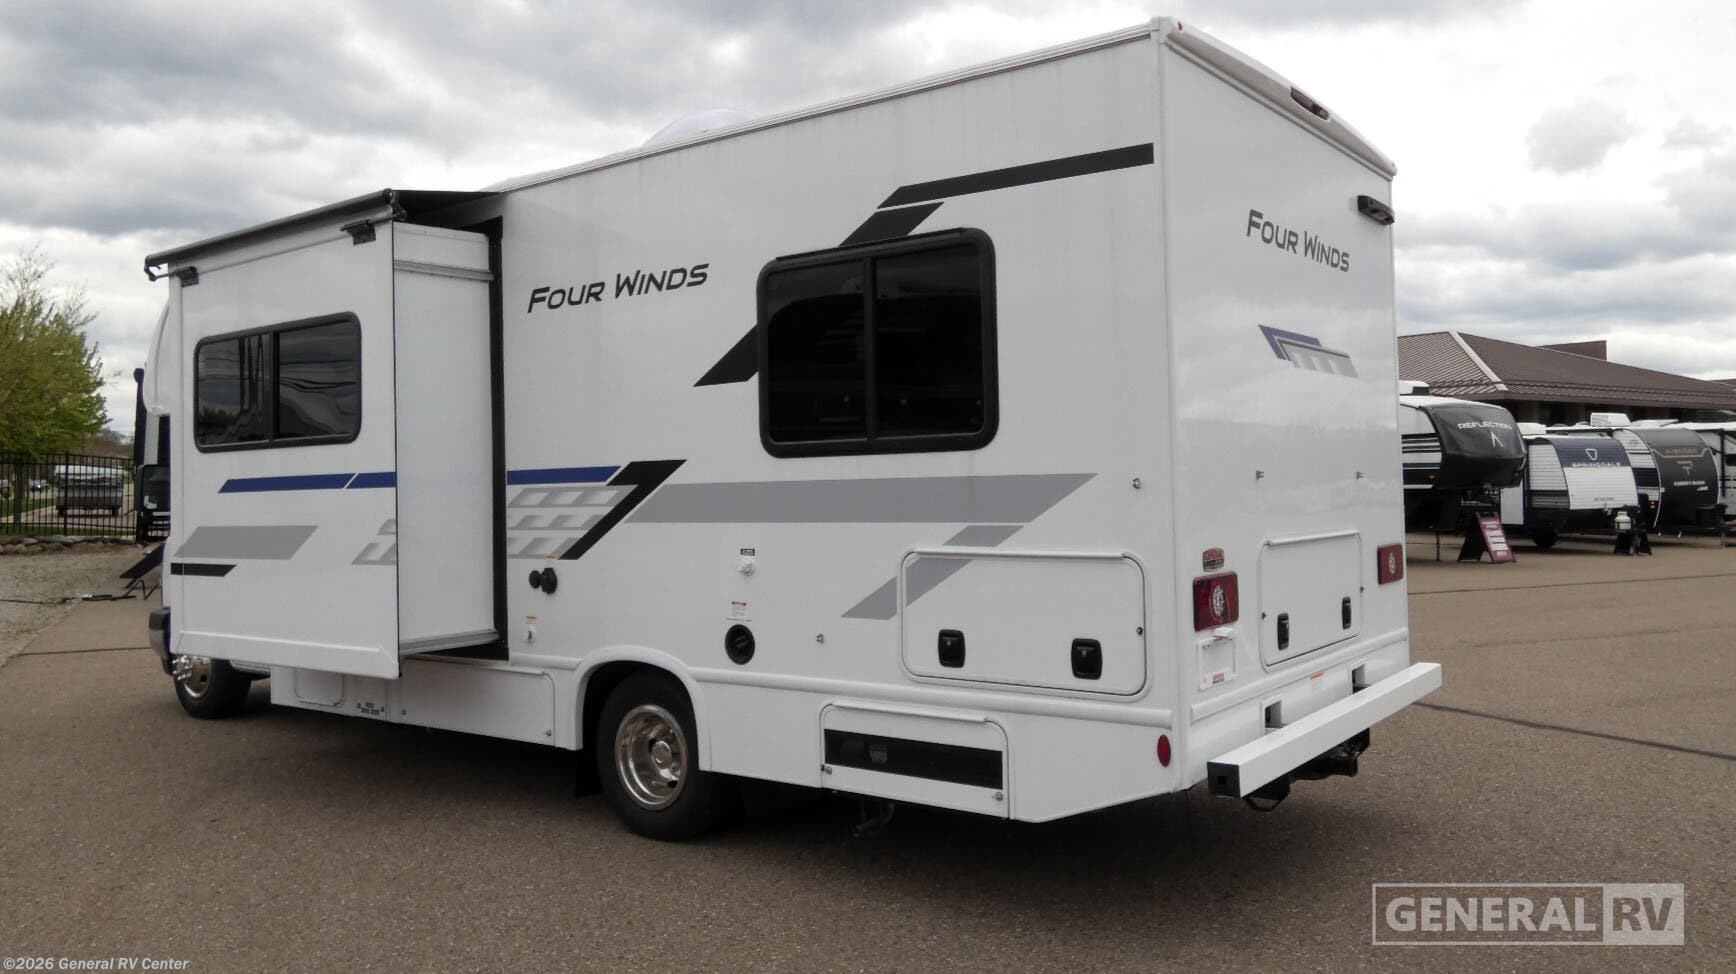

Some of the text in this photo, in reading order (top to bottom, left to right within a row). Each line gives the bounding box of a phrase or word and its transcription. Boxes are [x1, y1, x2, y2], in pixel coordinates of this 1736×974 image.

[1246, 208, 1350, 273] FOUR WINDS
[527, 263, 709, 313] FOUR WINDS
